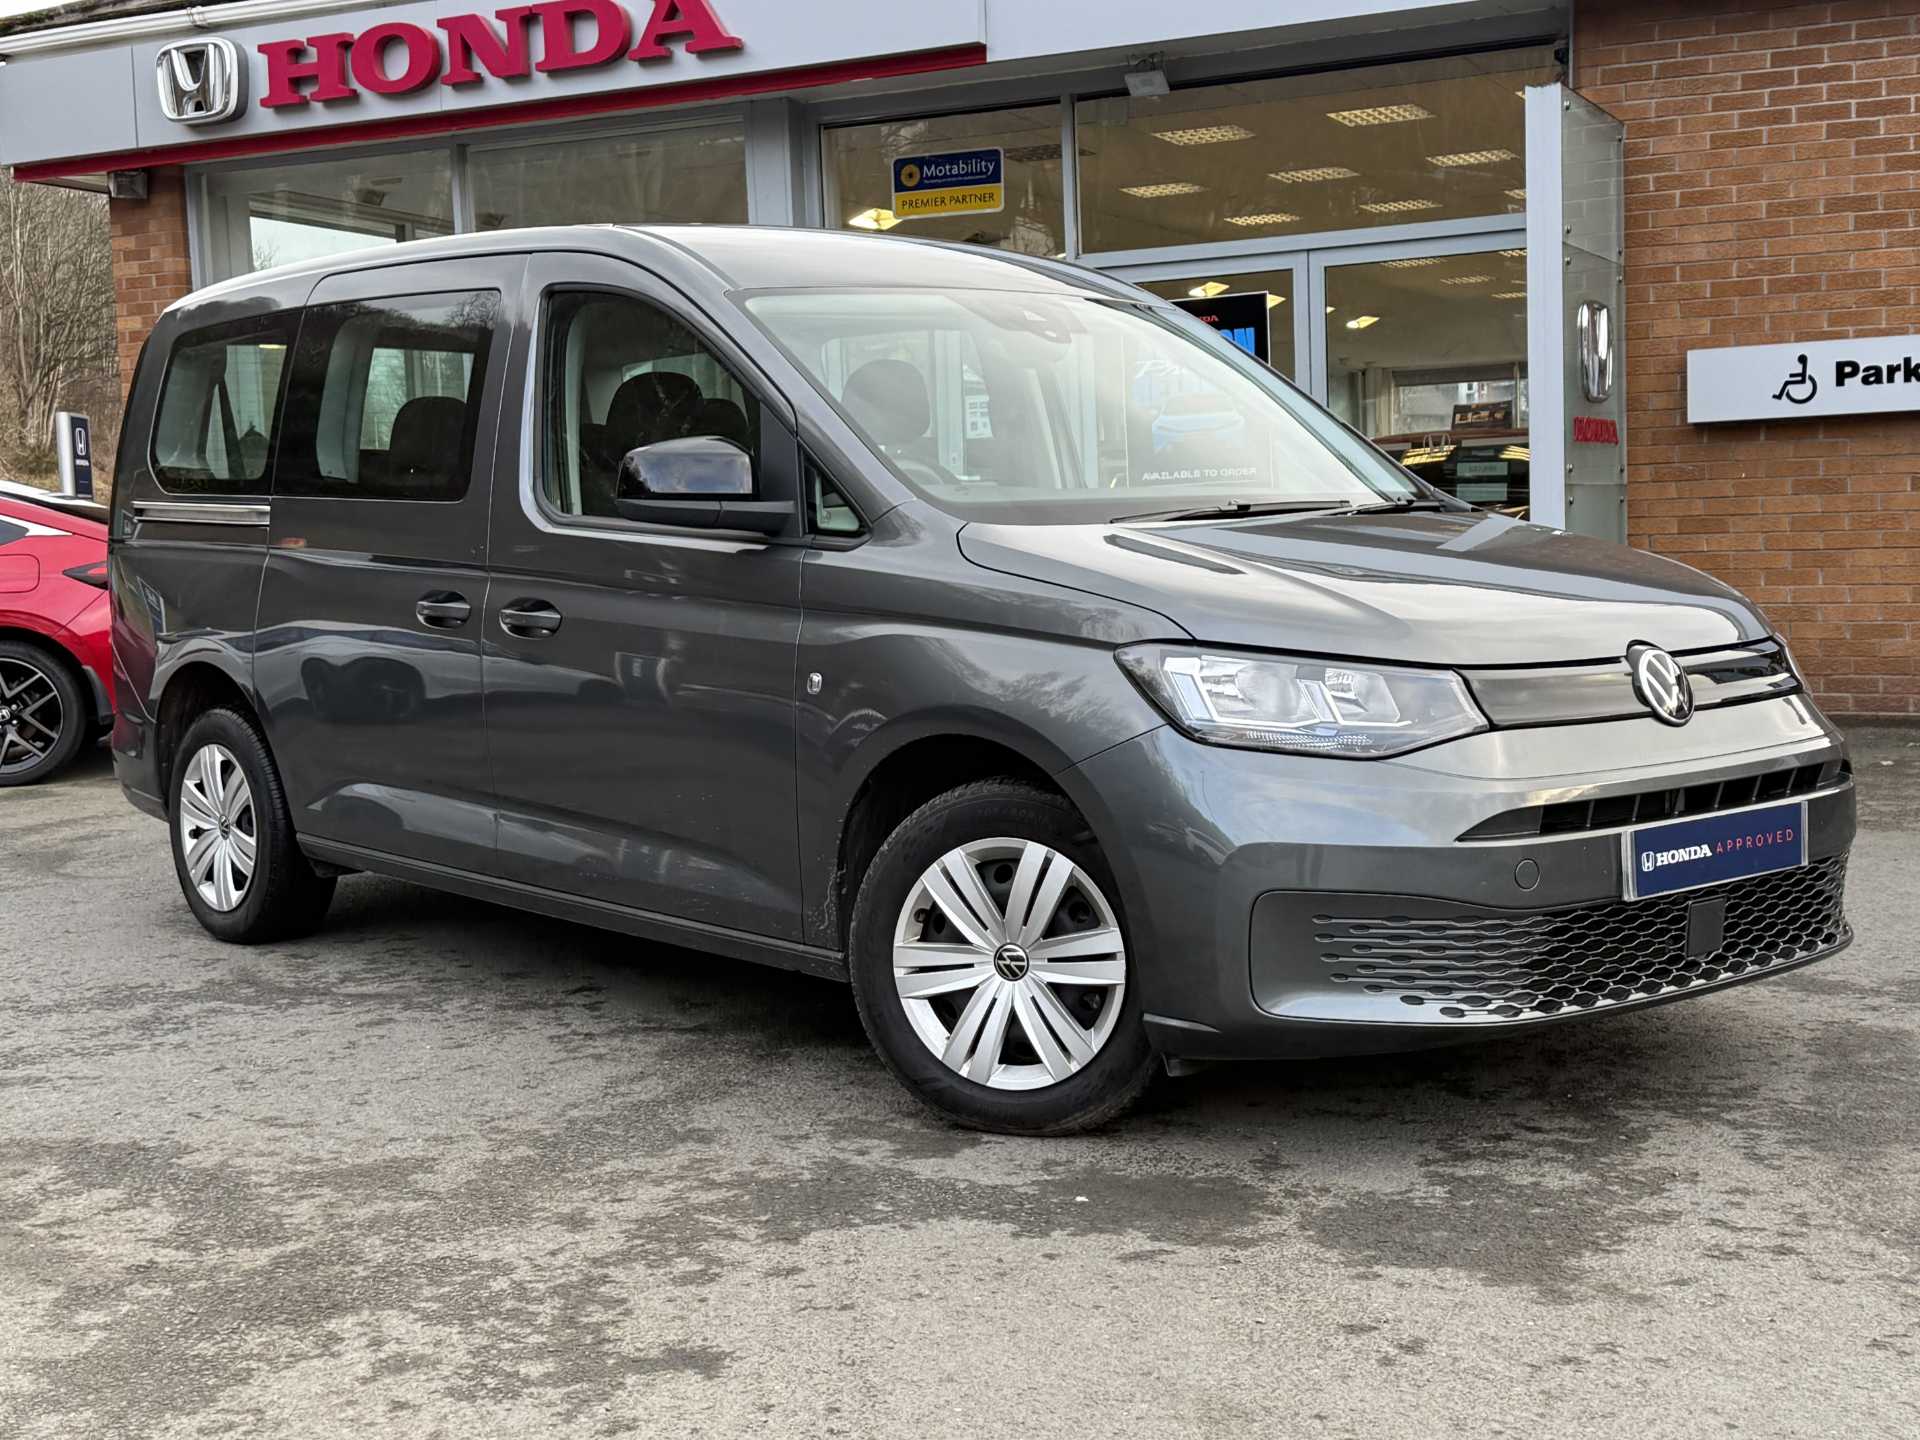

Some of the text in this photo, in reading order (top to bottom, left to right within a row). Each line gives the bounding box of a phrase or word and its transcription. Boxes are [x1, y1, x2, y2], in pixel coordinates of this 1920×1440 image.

[257, 0, 744, 108] HONDA
[922, 158, 996, 178] Motability
[902, 192, 995, 209] PREMIER PARTNER
[1835, 356, 1920, 387] Park
[1142, 467, 1257, 481] AVAILABLE TO ORDER
[1656, 844, 1712, 866] HONDA
[1715, 828, 1794, 854] APPROVED
